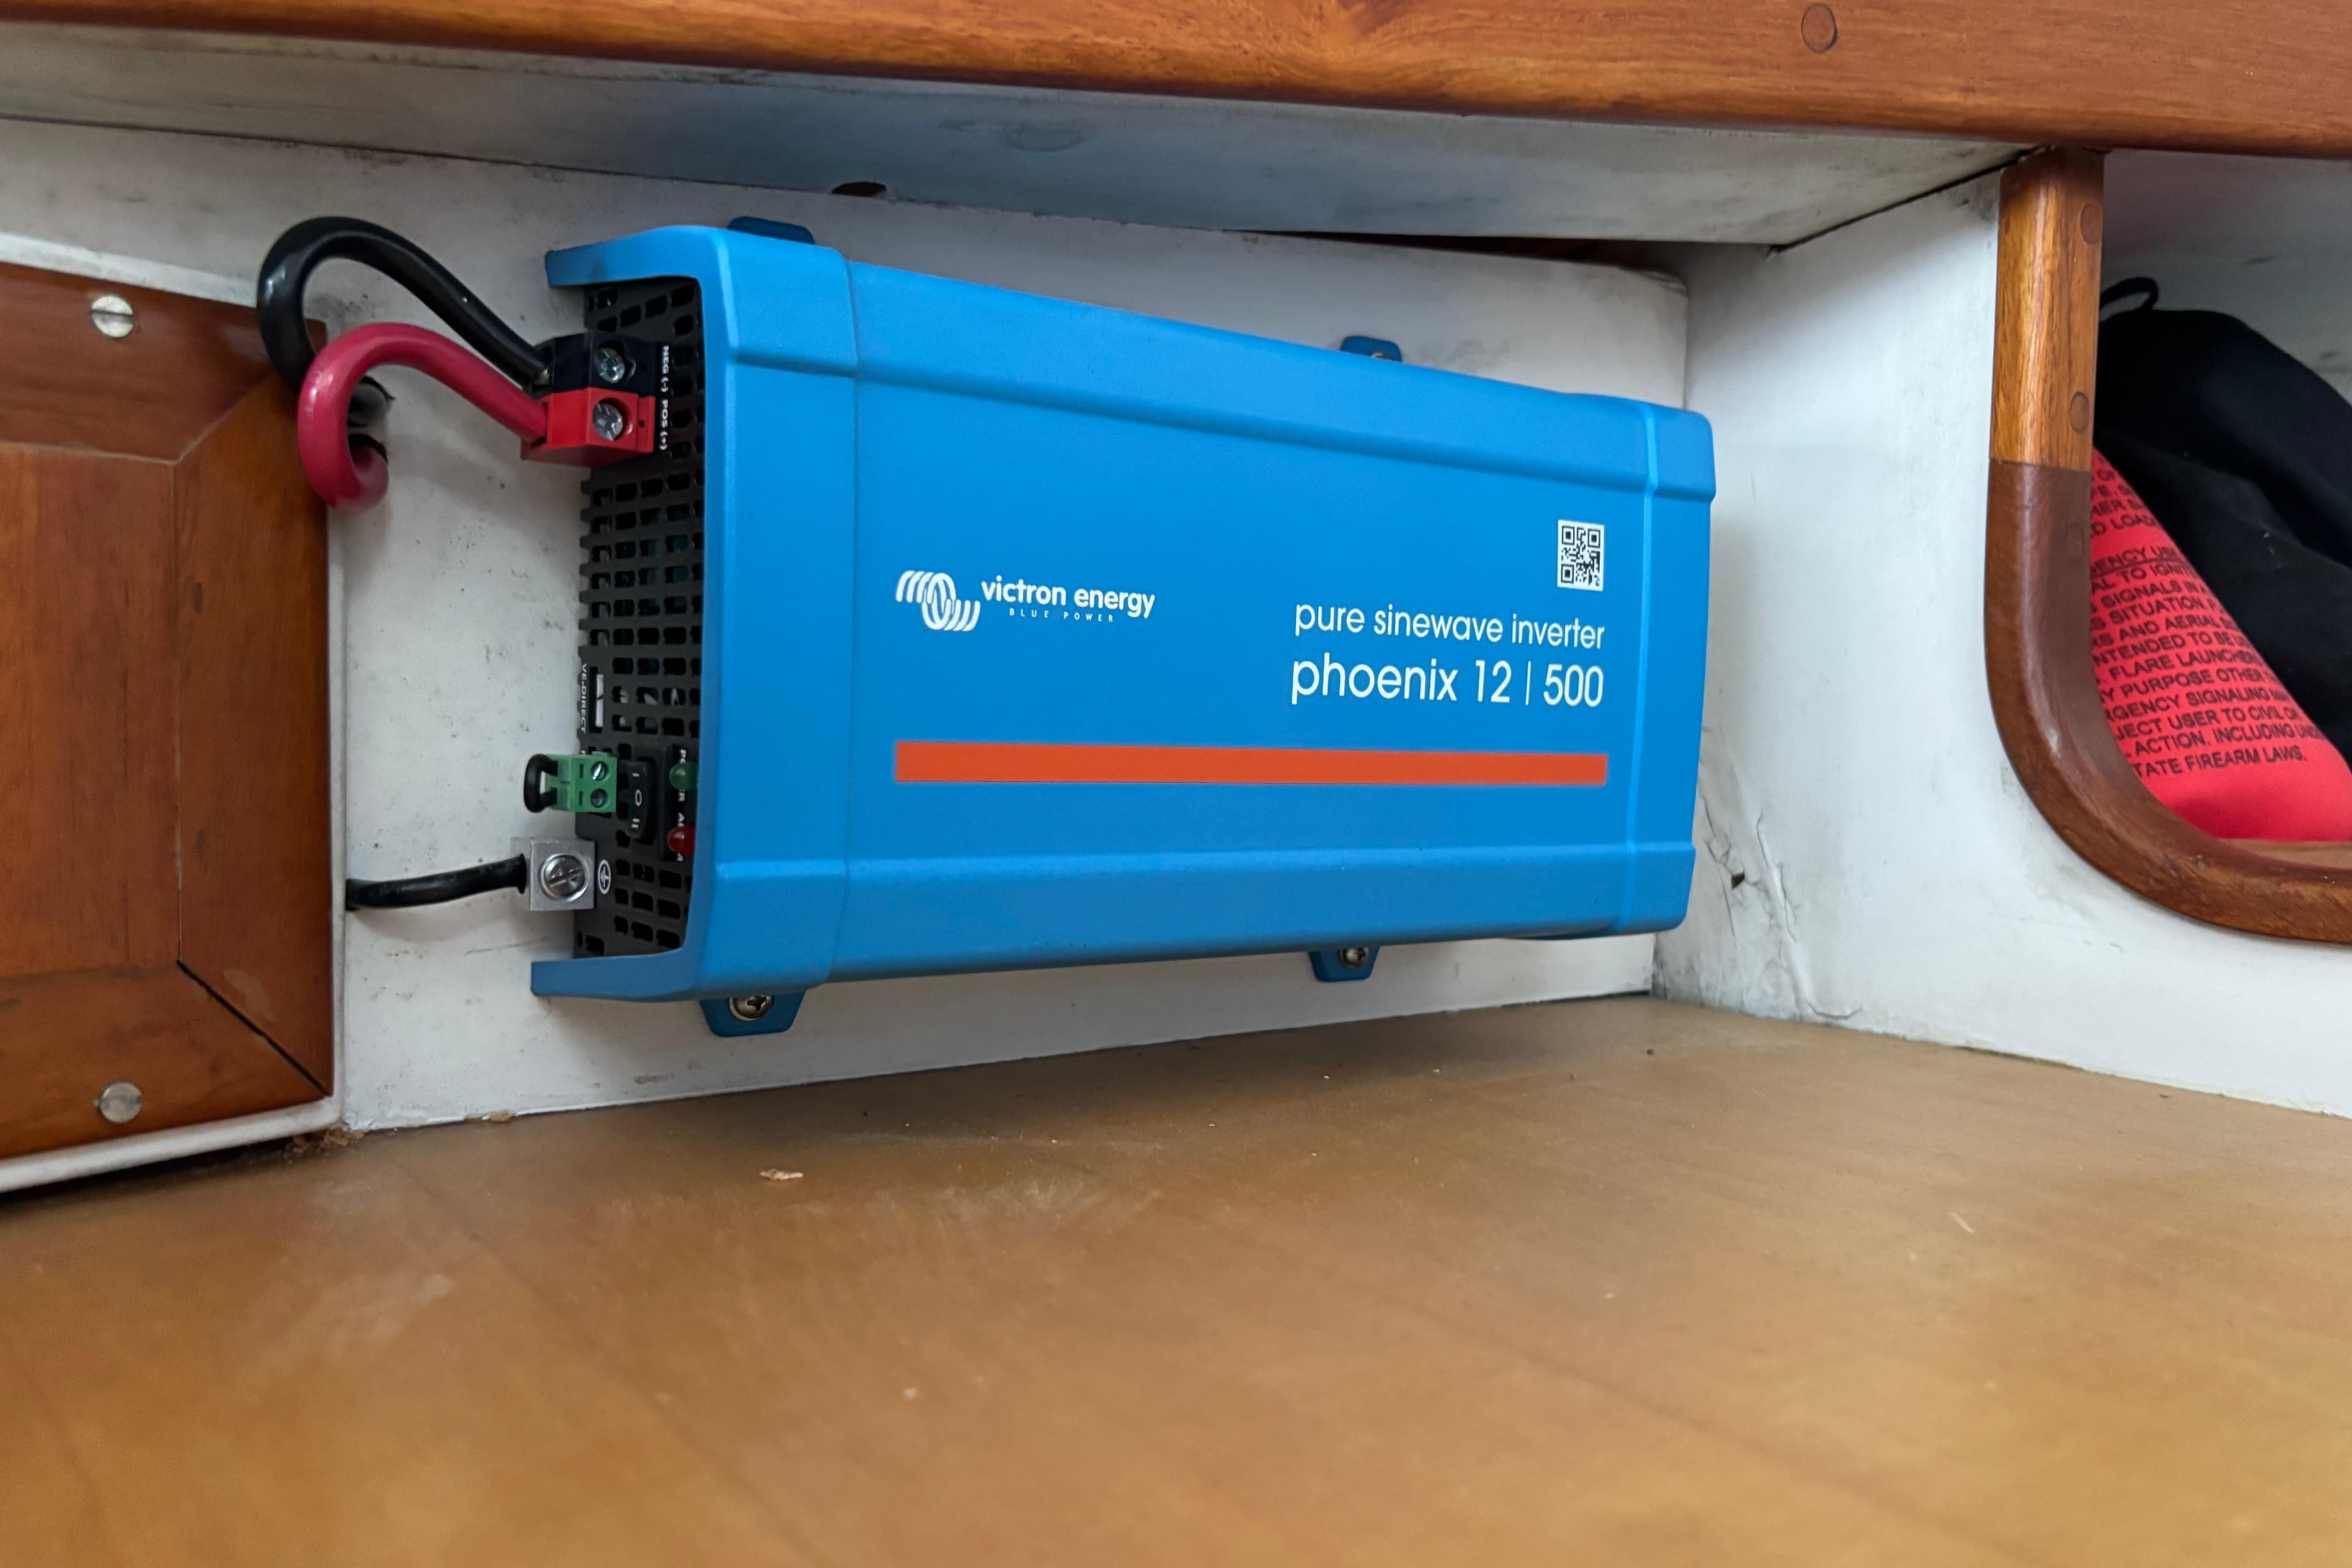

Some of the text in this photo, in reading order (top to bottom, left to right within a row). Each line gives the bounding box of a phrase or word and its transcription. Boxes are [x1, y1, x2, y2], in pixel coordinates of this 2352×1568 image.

[2116, 567, 2146, 582] TO
[981, 575, 1156, 619] victron energy
[2101, 579, 2182, 609] SIGNALS
[1009, 608, 1114, 623] BLUE POWER
[2109, 595, 2204, 624] SITUATION
[1295, 603, 1605, 649] pure sinewave inverter
[2119, 620, 2159, 641] AND
[2165, 615, 2220, 631] AERIAL
[2187, 631, 2211, 646] TO
[2214, 630, 2231, 646] BE
[1291, 652, 1458, 705] phoenix
[1475, 660, 1512, 703] 12
[1543, 663, 1604, 707] 500
[2109, 655, 2175, 680] FLARE
[2120, 669, 2214, 698] PURPOSE
[2215, 668, 2266, 682] OTHER
[2185, 687, 2271, 706] SIGNALING
[2167, 709, 2220, 730] USER
[2222, 707, 2247, 724] TO
[2248, 706, 2285, 721] CIVIL
[2214, 723, 2296, 743] INCLUDING
[2184, 748, 2261, 772] FIREARM
[2263, 745, 2307, 763] LAWS.
